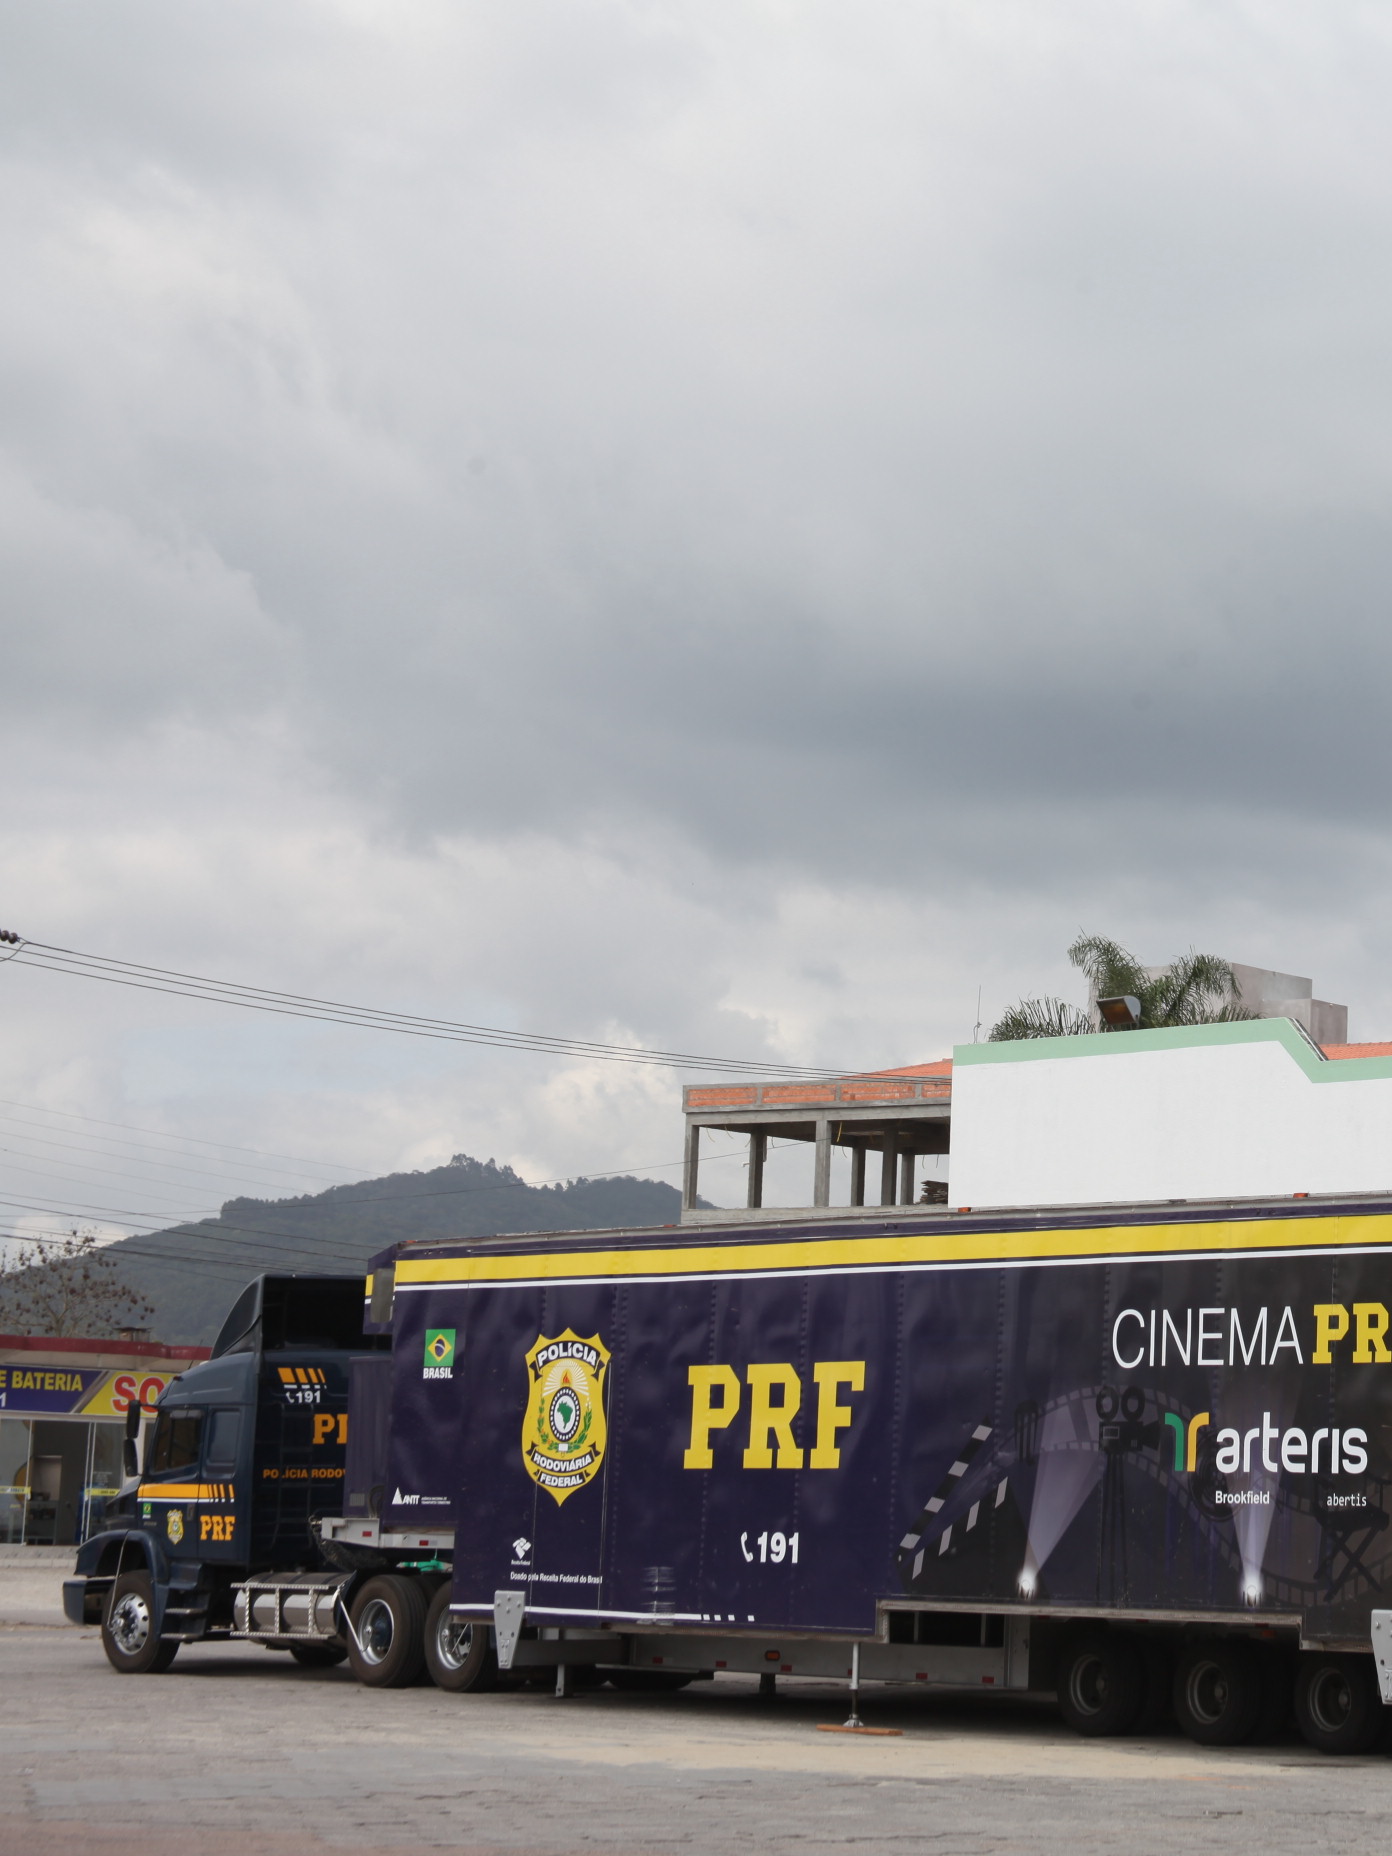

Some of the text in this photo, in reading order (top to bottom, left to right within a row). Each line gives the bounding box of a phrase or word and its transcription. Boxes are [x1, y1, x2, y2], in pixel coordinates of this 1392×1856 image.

[1112, 1306, 1304, 1369] CINEMA
[537, 1341, 598, 1368] POLÍCIA
[11, 1370, 83, 1392] BATERIA
[422, 1366, 454, 1379] BRASIL
[295, 1390, 321, 1404] 191
[683, 1360, 866, 1470] PRF
[1215, 1411, 1369, 1475] arteris
[533, 1452, 593, 1472] RODOVIÁRIA
[539, 1473, 584, 1487] FEDERAL
[1215, 1490, 1270, 1504] Brookfield
[1326, 1493, 1368, 1507] abertis
[200, 1515, 236, 1541] PRF
[757, 1531, 799, 1564] 191
[510, 1571, 528, 1581] Doado
[539, 1573, 559, 1582] Receita
[559, 1574, 579, 1583] Federal
[580, 1575, 587, 1583] do
